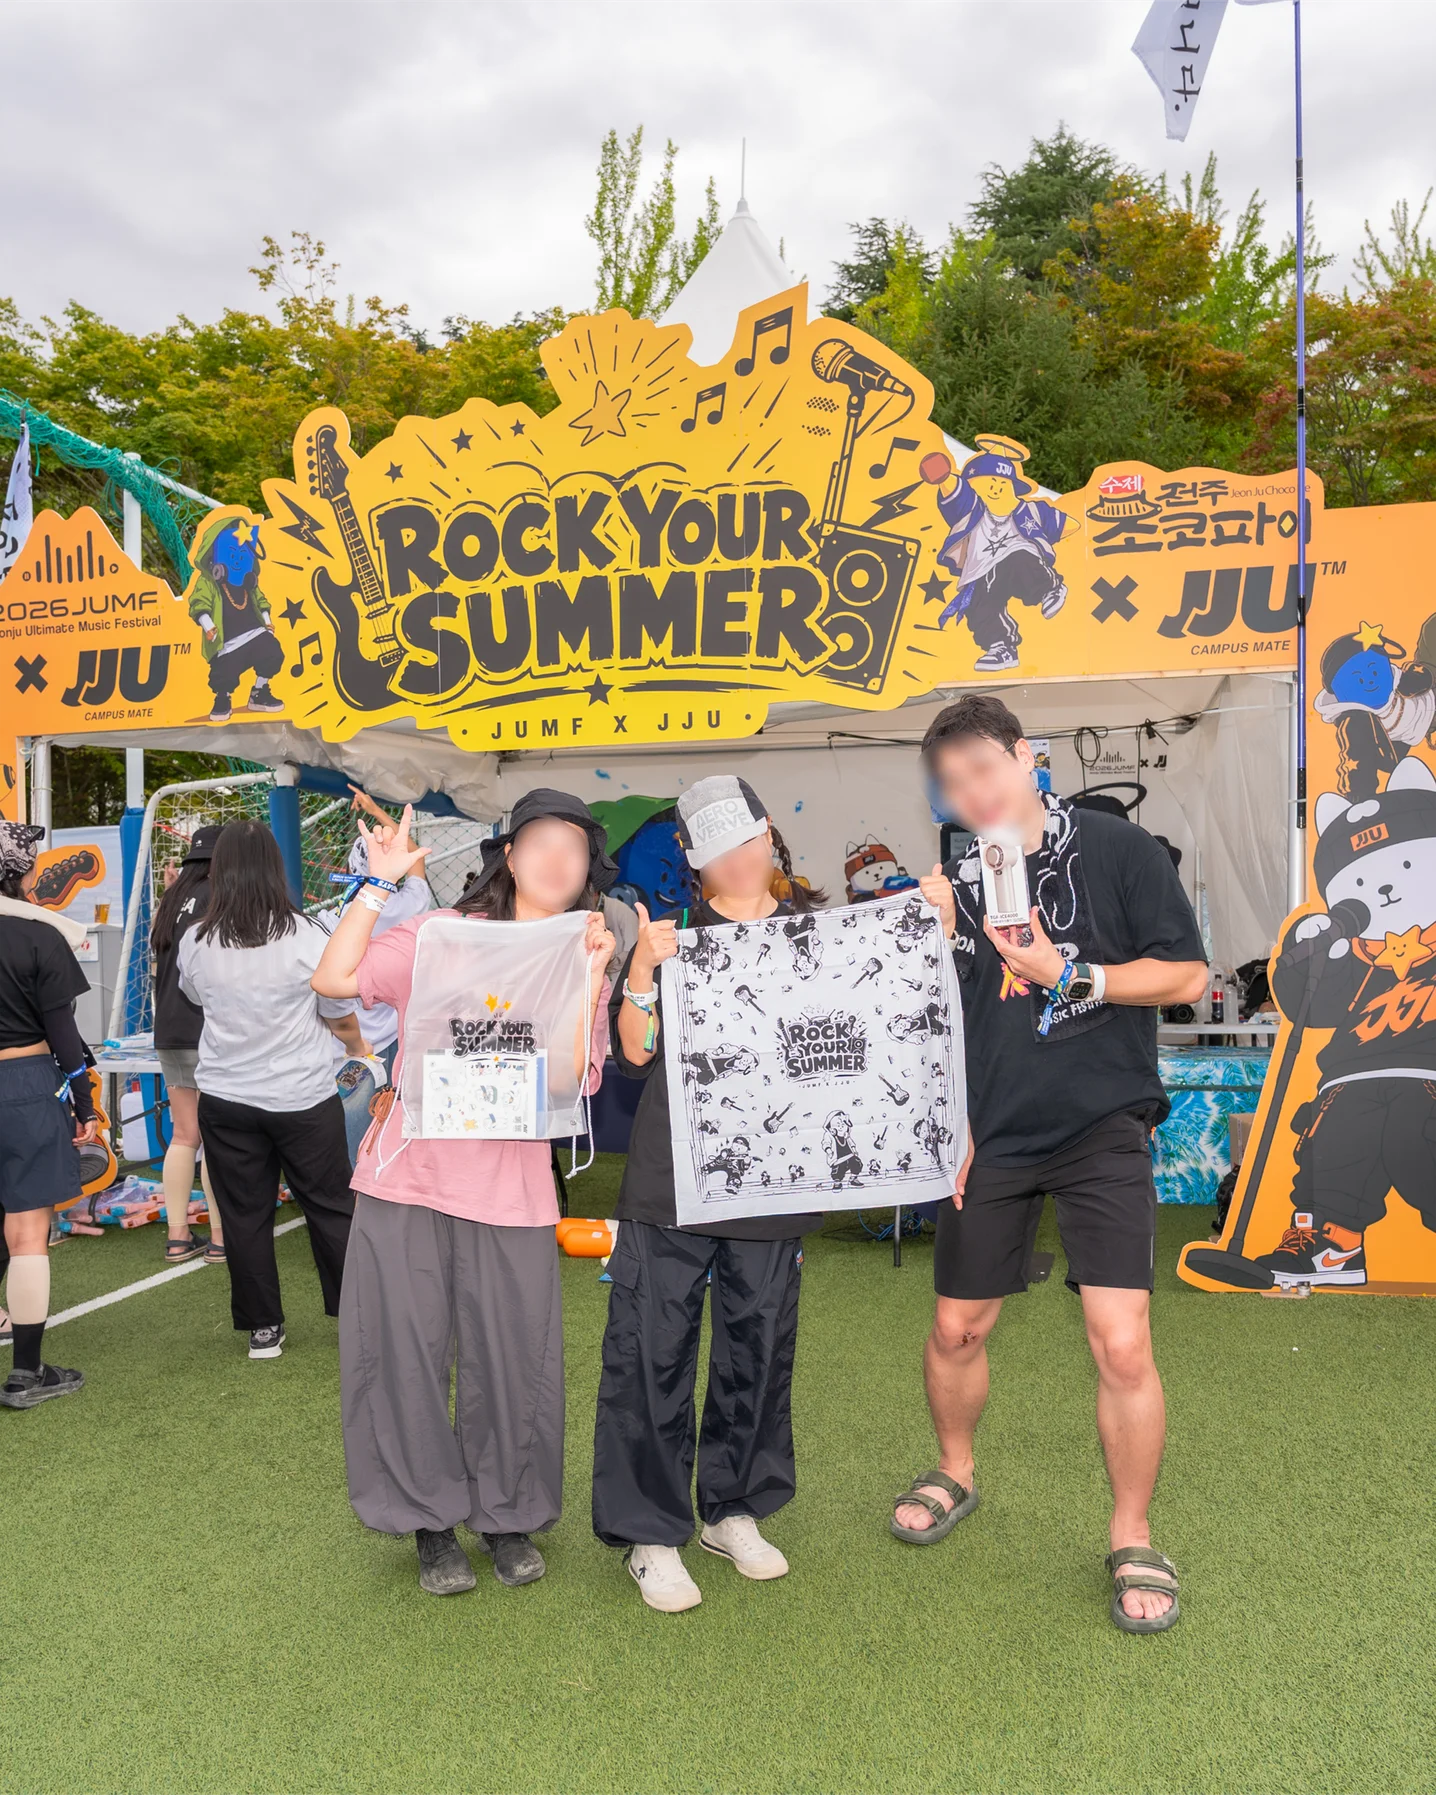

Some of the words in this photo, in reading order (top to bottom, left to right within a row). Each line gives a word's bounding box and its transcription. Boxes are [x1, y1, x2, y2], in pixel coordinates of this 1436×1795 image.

[1170, 0, 1201, 111] 니다.
[996, 462, 1012, 476] JJU
[1099, 474, 1143, 494] 수제
[1154, 480, 1229, 507] 전주
[1230, 488, 1252, 499] Jeon
[1253, 487, 1265, 497] Ju
[1265, 485, 1296, 496] Choco
[376, 488, 617, 597] ROCK
[619, 483, 813, 568] YOUR
[0, 591, 158, 622] 026JUMF
[1156, 562, 1318, 639] JJU
[25, 623, 75, 637] Ultimate
[78, 619, 111, 632] Music
[115, 615, 161, 629] Festival
[398, 566, 836, 695] SUMMER
[1190, 642, 1250, 656] CAMPUS
[1252, 639, 1291, 653] MATE
[60, 644, 171, 707] JJU
[84, 709, 125, 721] CAMPUS
[127, 708, 154, 719] MATE
[491, 716, 585, 740] JUMF
[613, 714, 628, 734] X
[657, 709, 722, 732] JJU
[696, 800, 739, 830] AERO
[696, 811, 750, 844] VERVE
[1355, 826, 1383, 848] JJU
[450, 1019, 498, 1037] ROCK
[500, 1021, 535, 1037] YOUR
[788, 1021, 850, 1044] ROCK
[453, 1035, 538, 1057] SUMMER
[799, 1040, 849, 1056] YOUR
[786, 1055, 866, 1078] SUMMER
